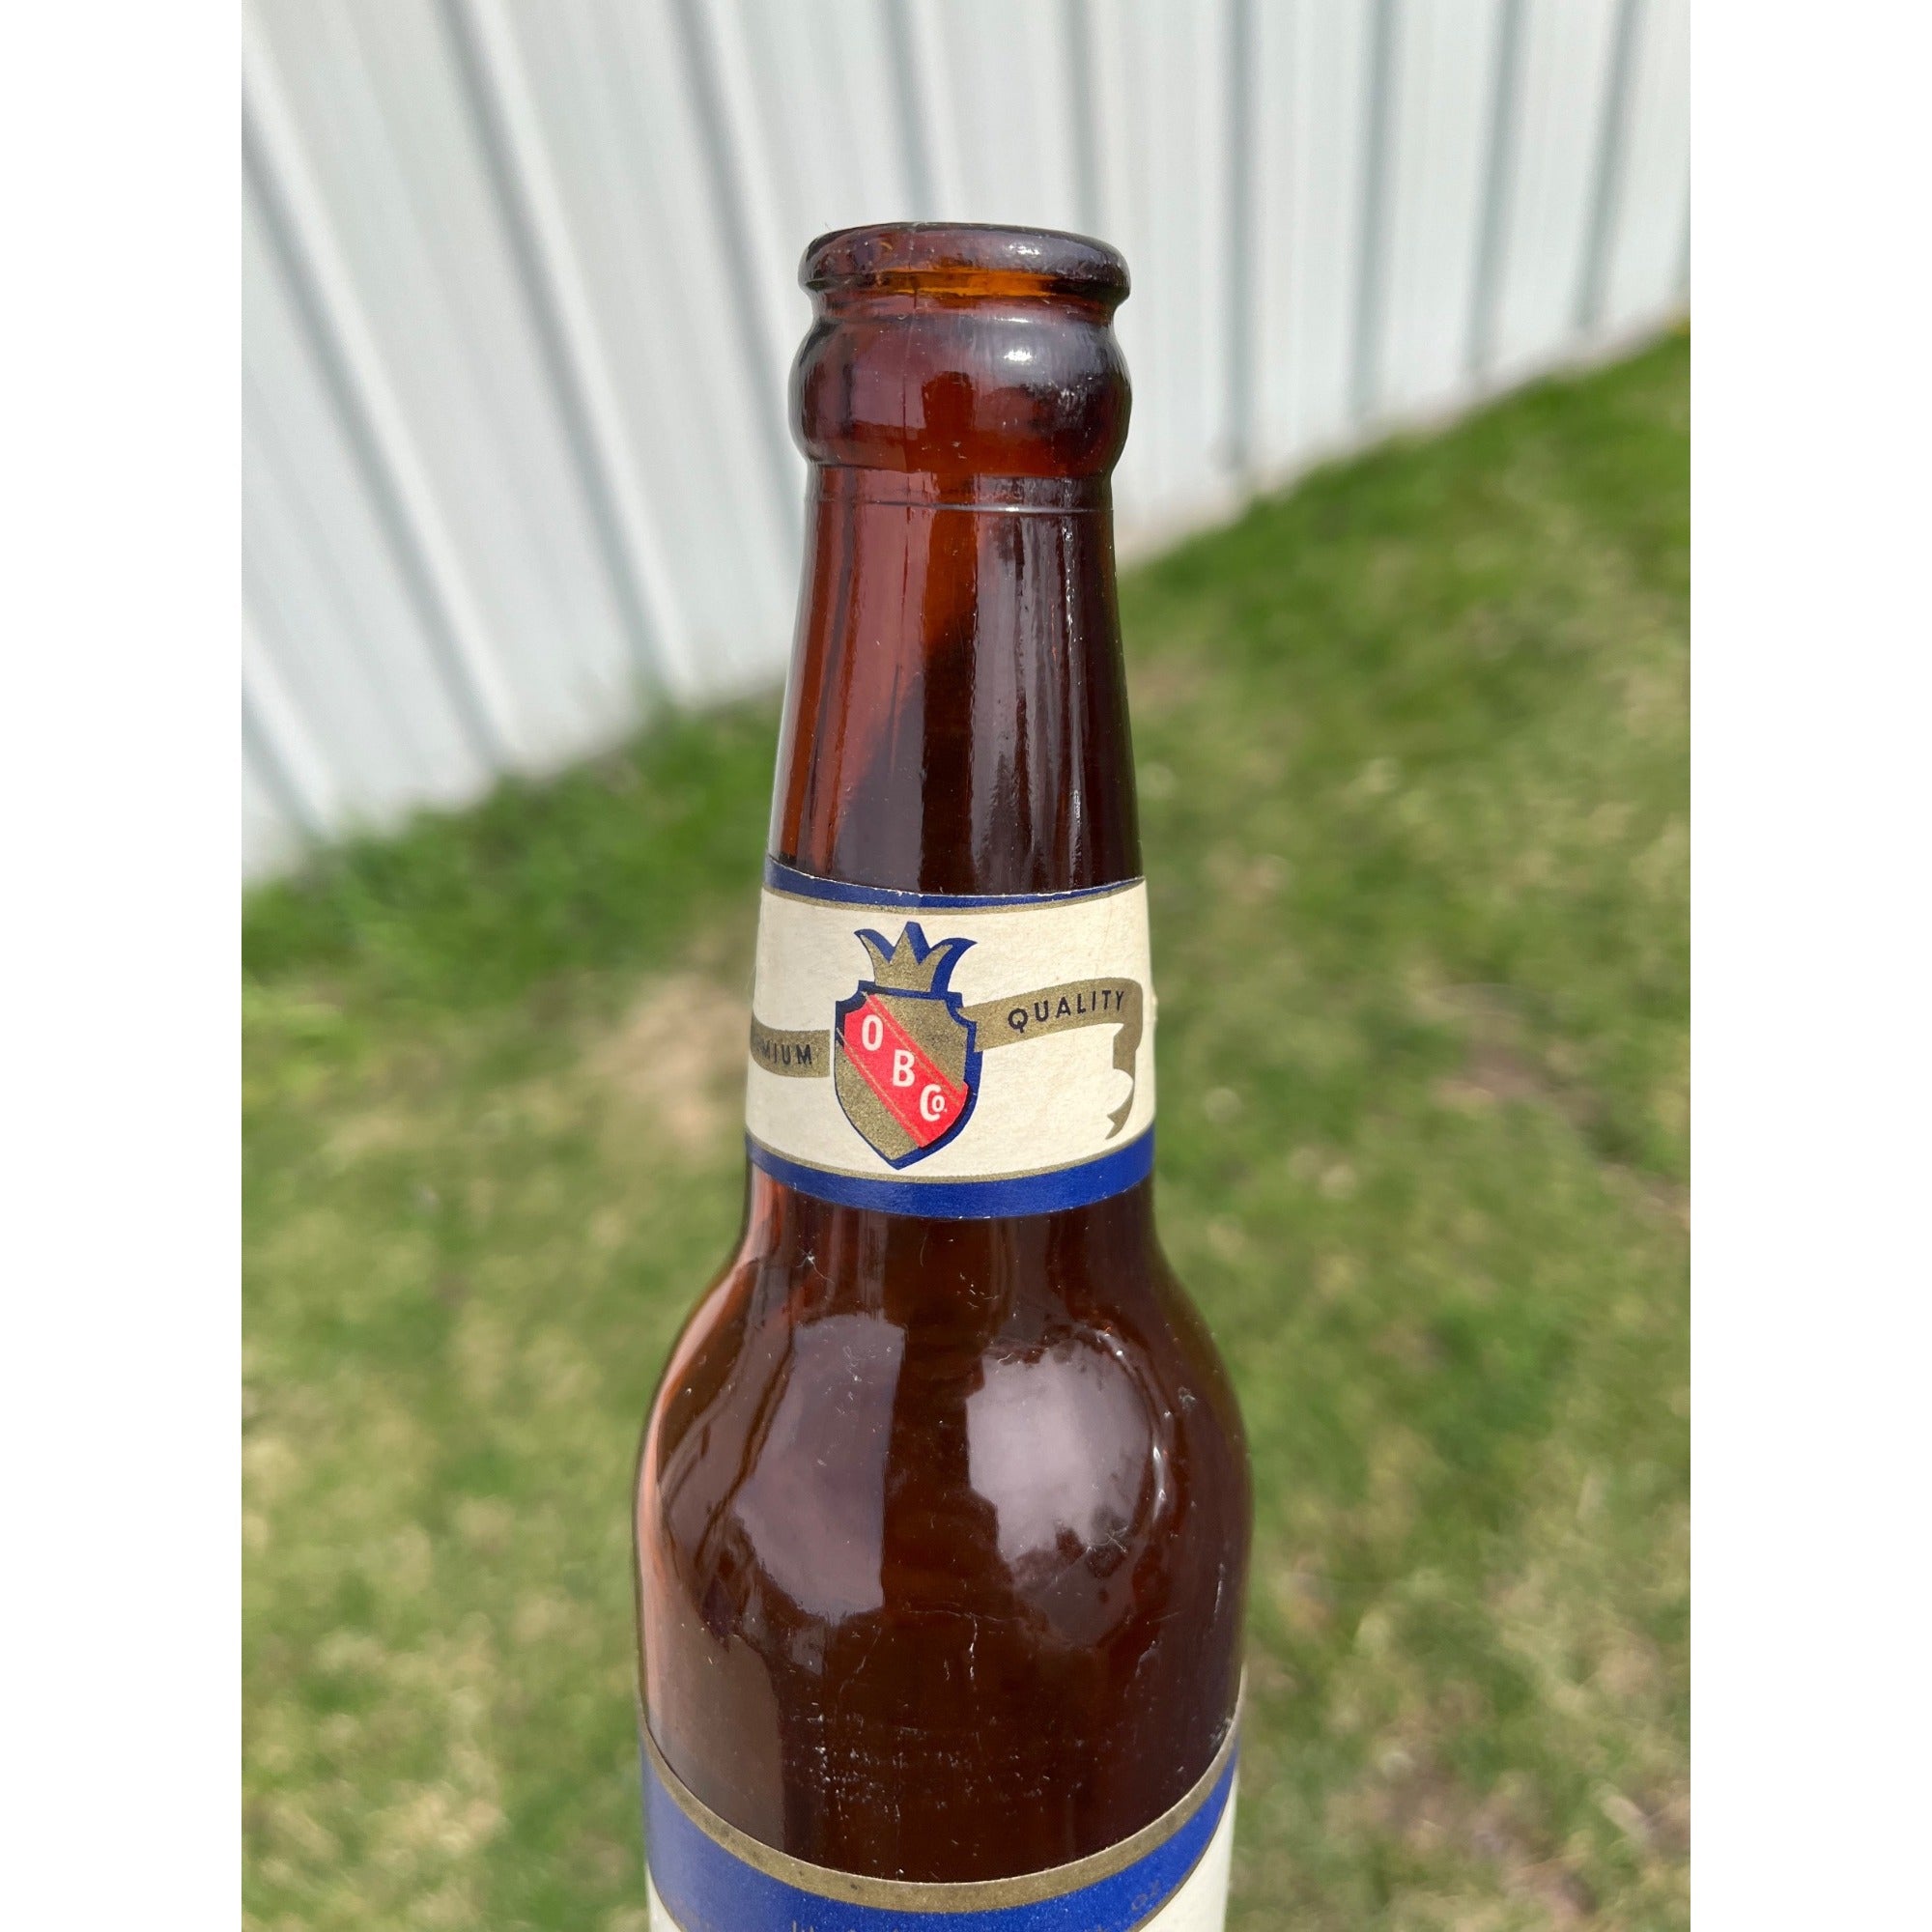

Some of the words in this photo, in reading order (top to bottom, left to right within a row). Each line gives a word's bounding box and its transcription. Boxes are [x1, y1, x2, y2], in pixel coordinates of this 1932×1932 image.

[1008, 989, 1124, 1034] QUALITY
[759, 1039, 813, 1065] MIUM
[862, 1013, 884, 1051] O
[892, 1048, 916, 1088] B
